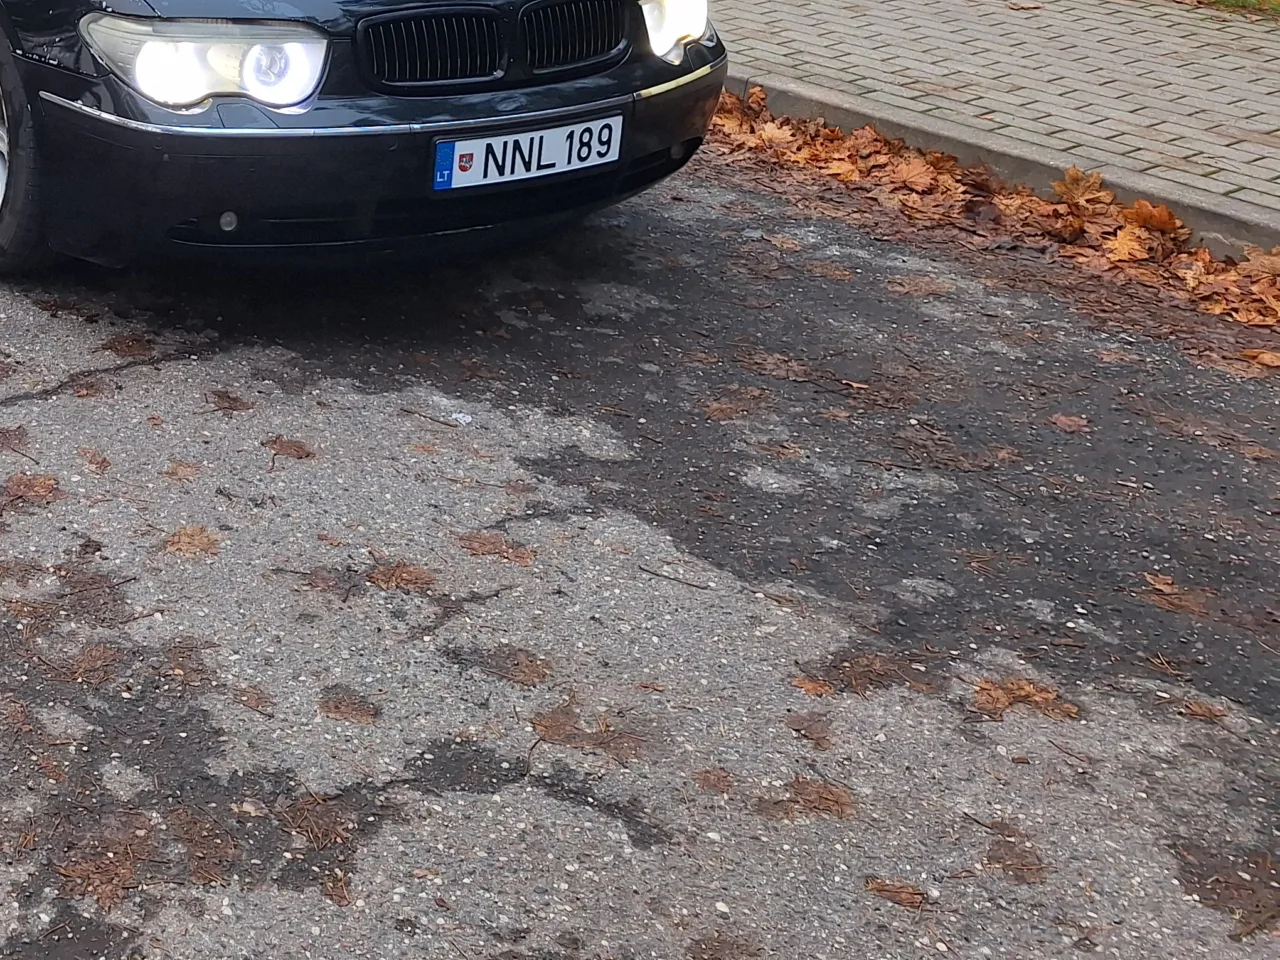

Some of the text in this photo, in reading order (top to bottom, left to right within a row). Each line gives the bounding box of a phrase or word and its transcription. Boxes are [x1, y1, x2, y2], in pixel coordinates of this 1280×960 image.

[482, 122, 613, 179] NNL 189
[436, 170, 450, 182] LT
